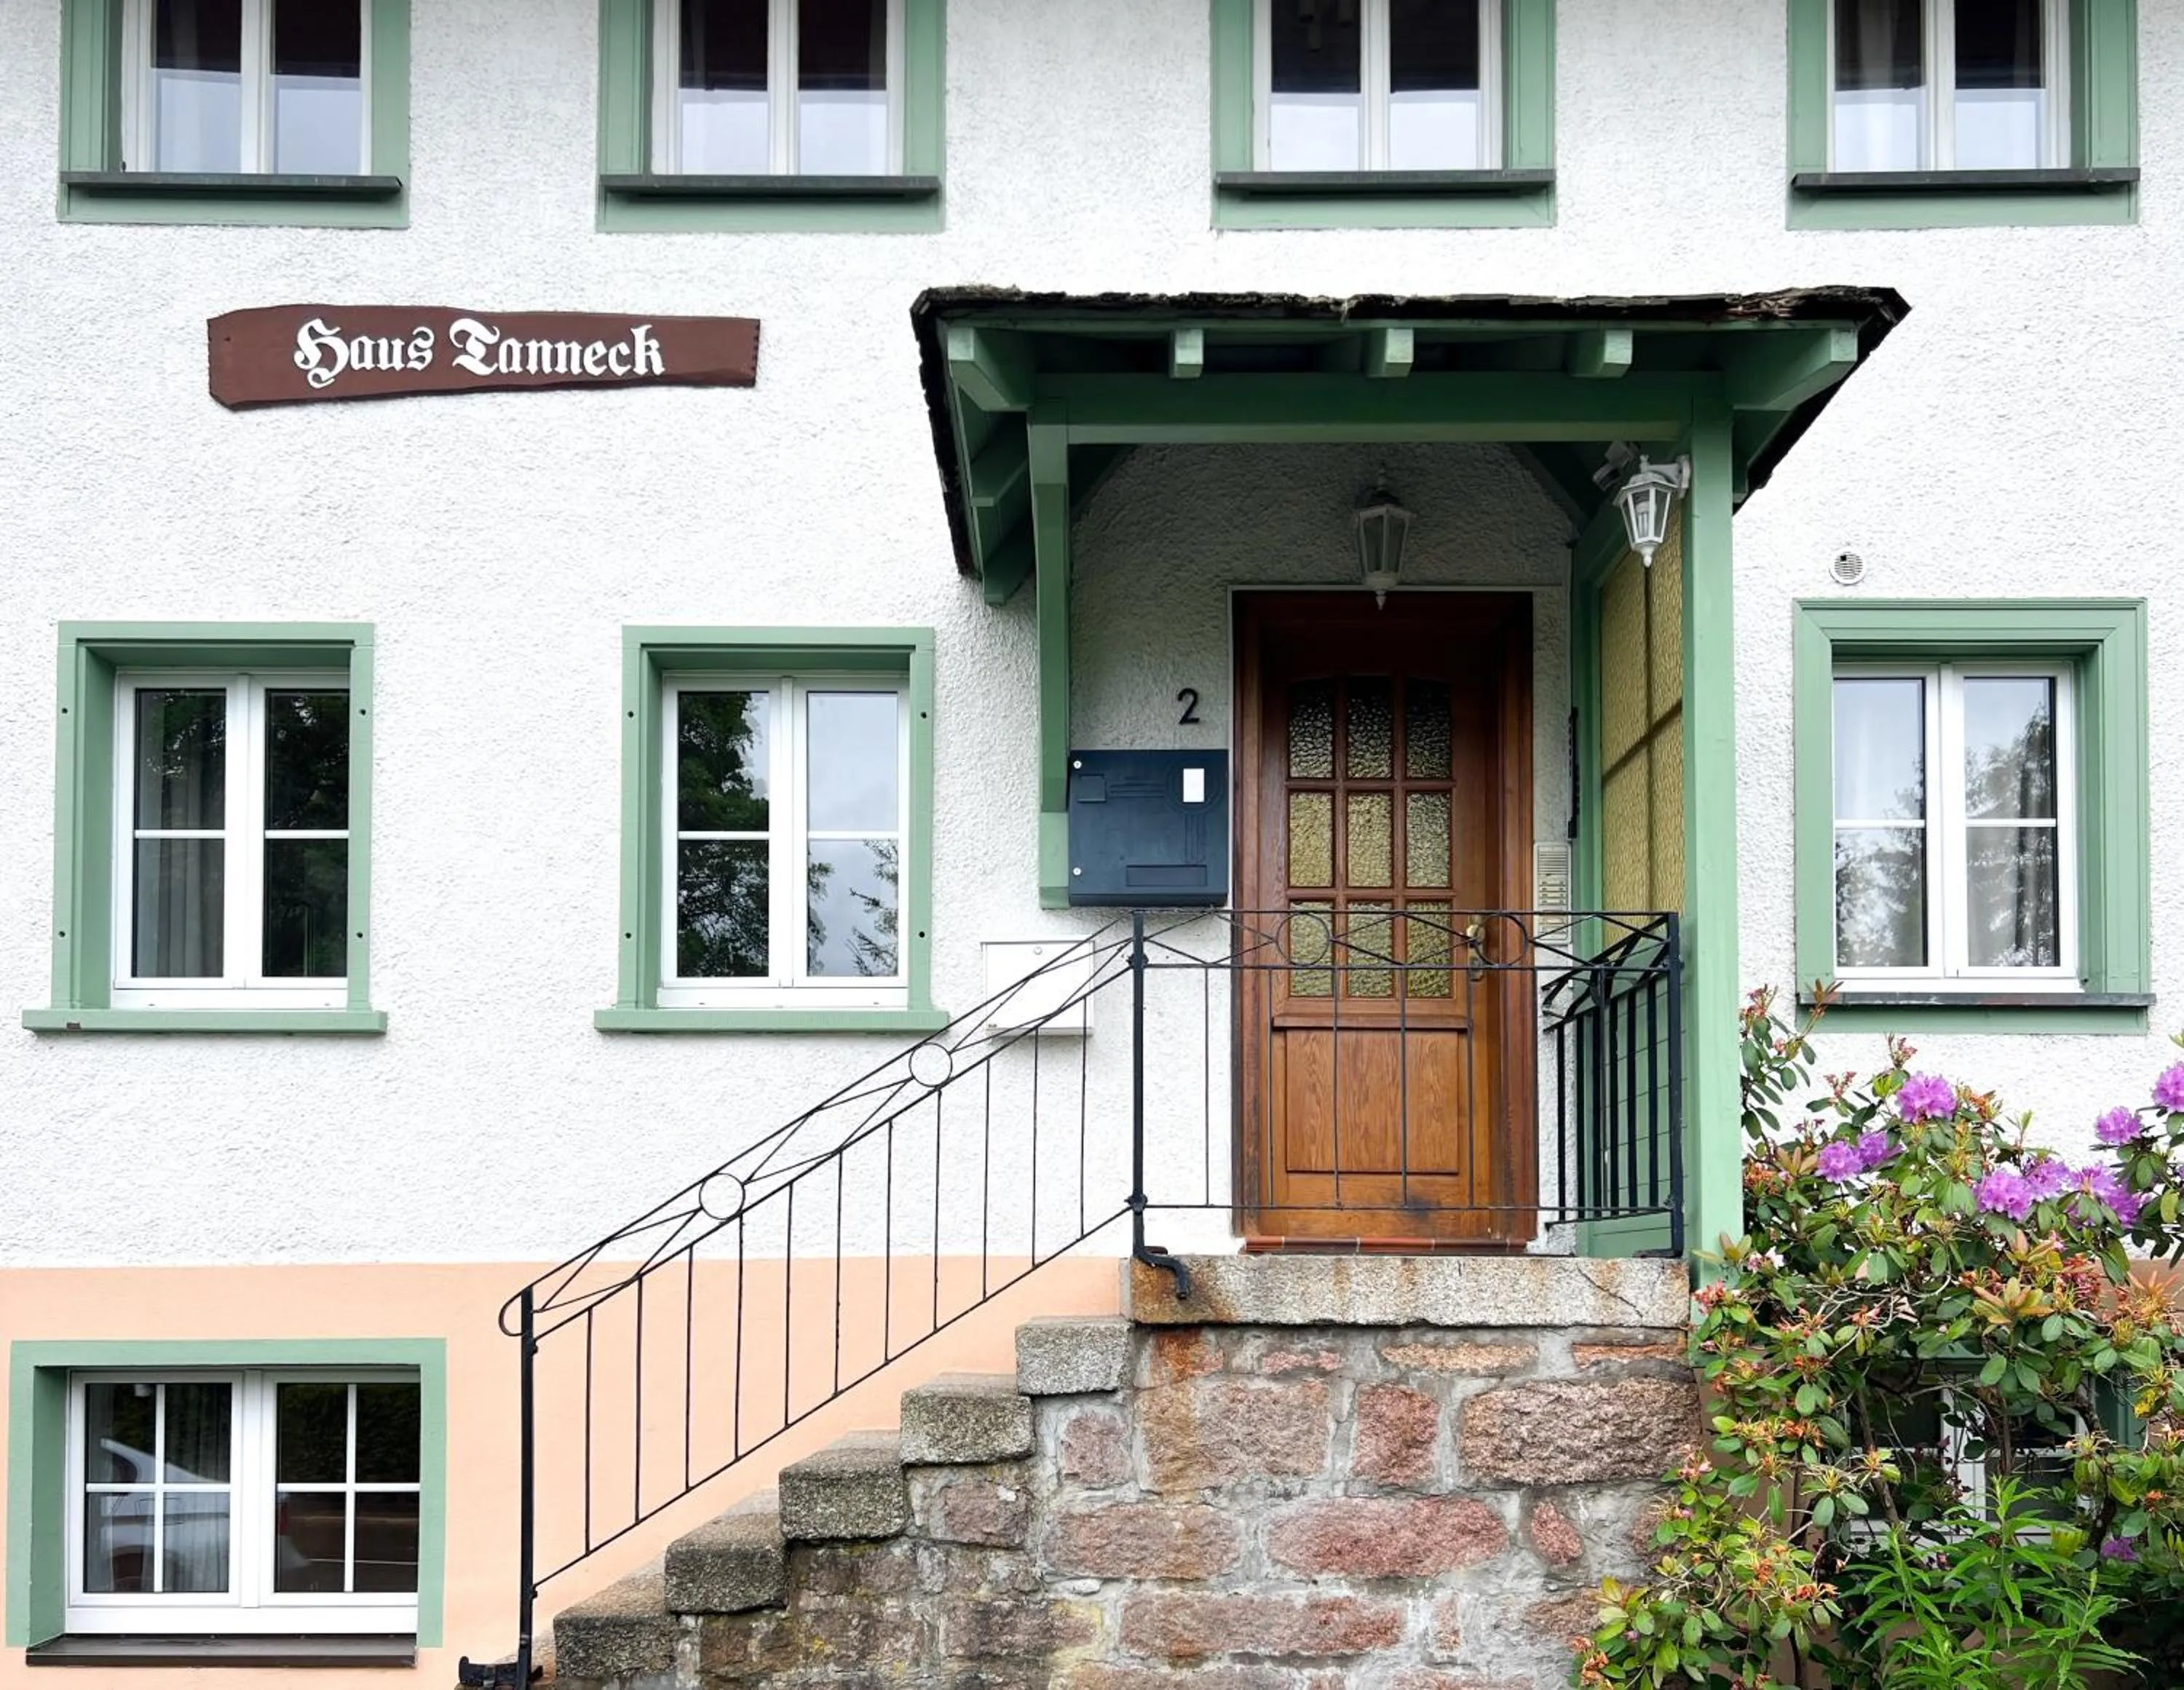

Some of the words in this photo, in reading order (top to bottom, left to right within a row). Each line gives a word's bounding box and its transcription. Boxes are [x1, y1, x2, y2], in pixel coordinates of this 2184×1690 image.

[294, 318, 435, 389] Haus
[448, 318, 665, 377] Tanneck
[1176, 688, 1200, 726] 2
